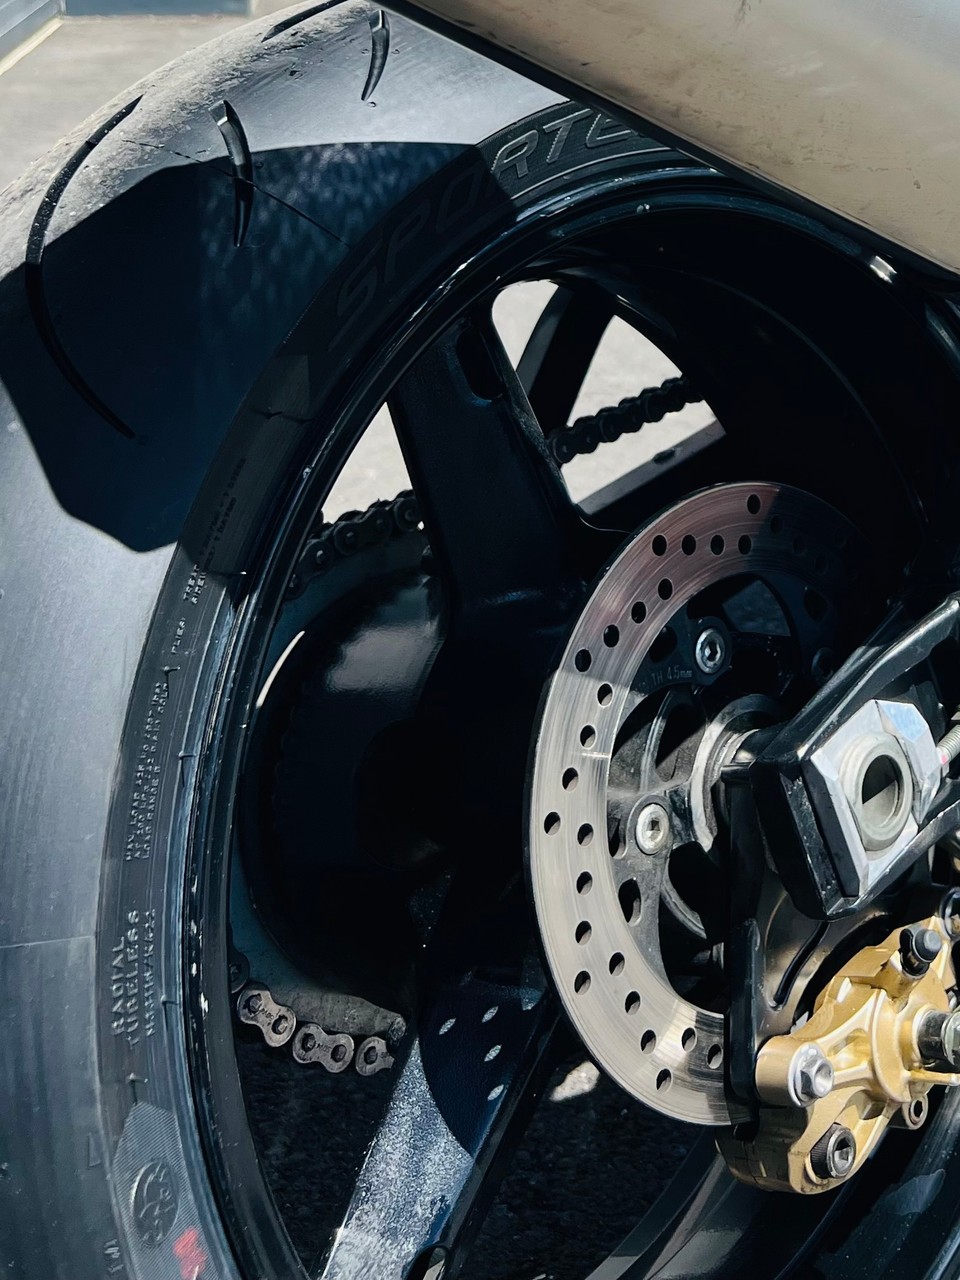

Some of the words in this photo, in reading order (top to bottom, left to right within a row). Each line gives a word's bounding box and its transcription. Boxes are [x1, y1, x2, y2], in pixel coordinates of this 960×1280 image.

[328, 107, 640, 352] SPORTE
[111, 936, 125, 1036] RADIAL
[125, 910, 139, 1051] TUBELESS
